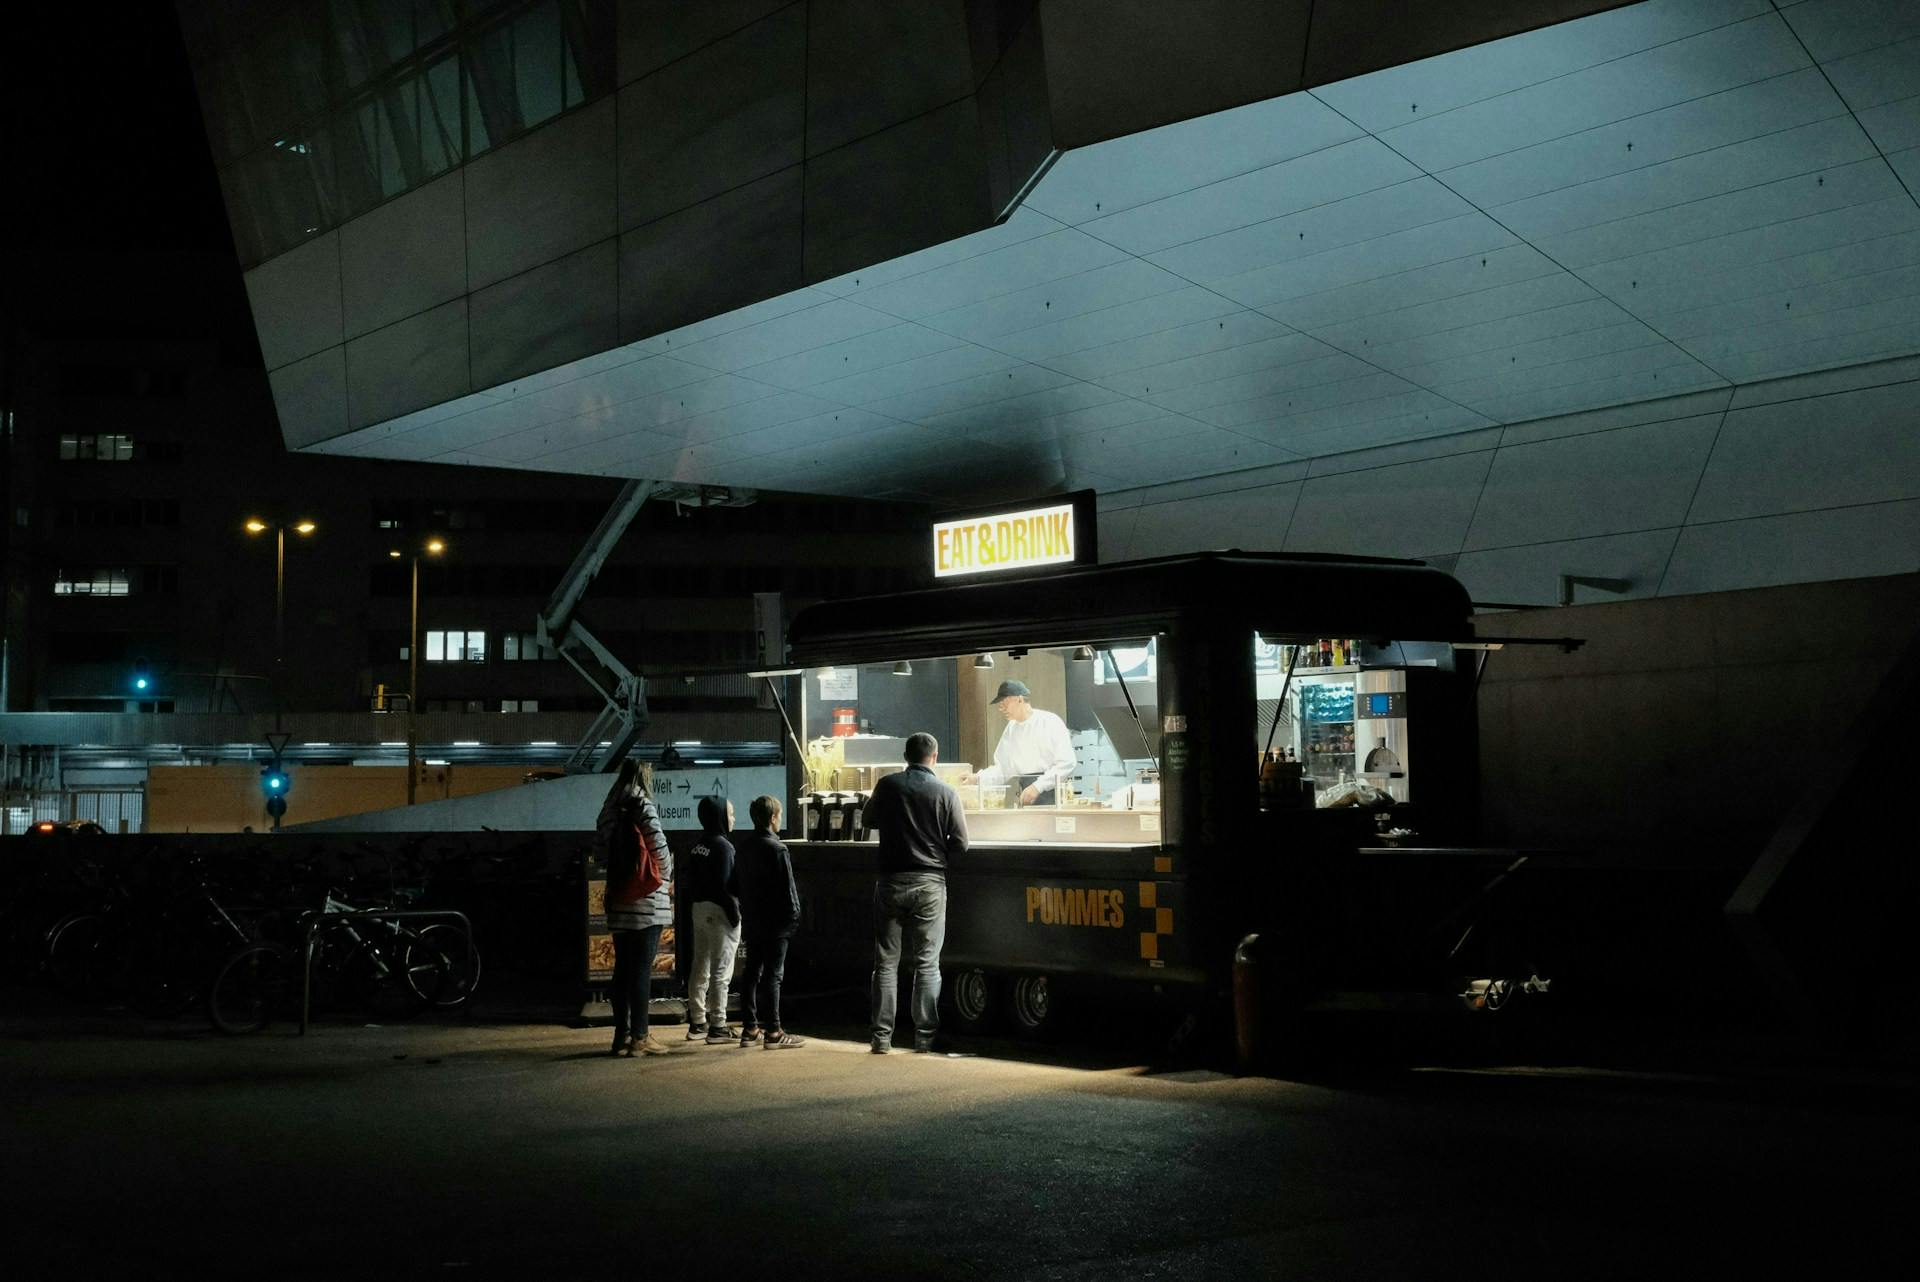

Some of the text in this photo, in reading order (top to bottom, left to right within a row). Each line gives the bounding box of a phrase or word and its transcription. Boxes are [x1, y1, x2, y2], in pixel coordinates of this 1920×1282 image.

[937, 511, 1070, 570] EAT&DRINK
[652, 778, 672, 794] Welt
[1025, 886, 1125, 929] POMMES
